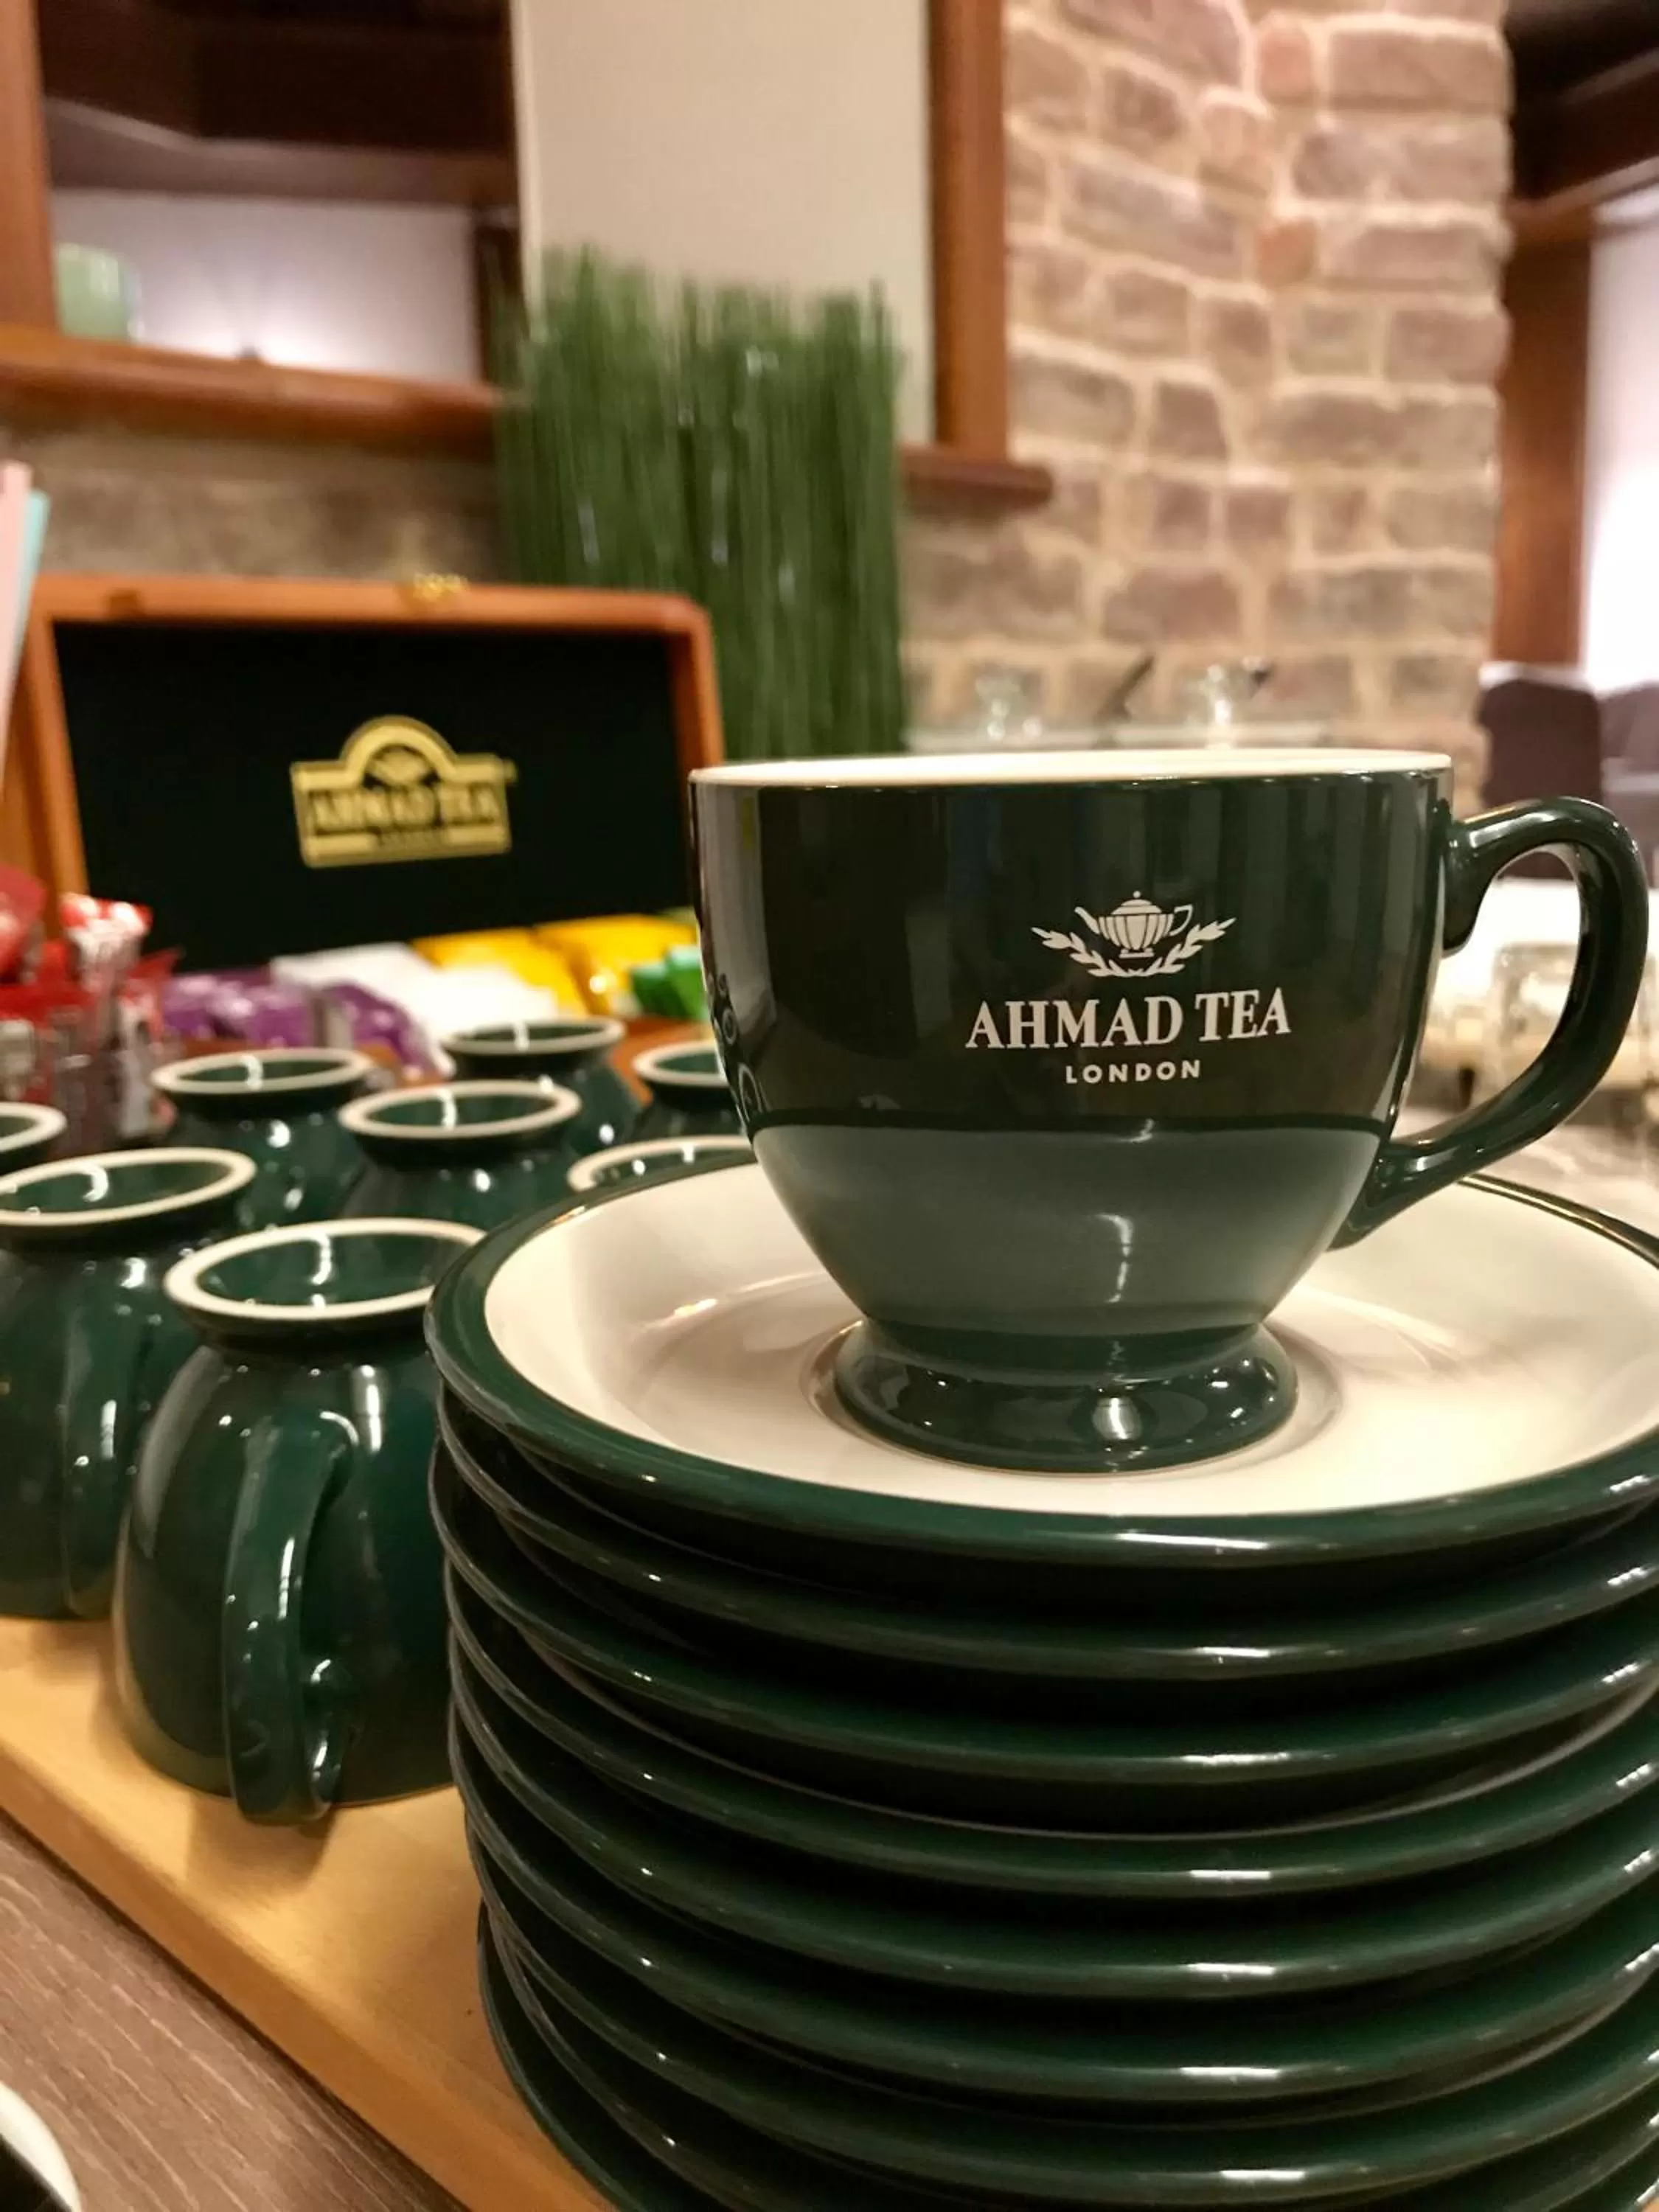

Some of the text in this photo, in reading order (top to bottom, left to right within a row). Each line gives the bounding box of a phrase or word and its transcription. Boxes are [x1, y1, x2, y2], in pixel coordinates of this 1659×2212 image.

[965, 987, 1292, 1048] AHMAD TEA
[1065, 1060, 1200, 1084] LONDON
